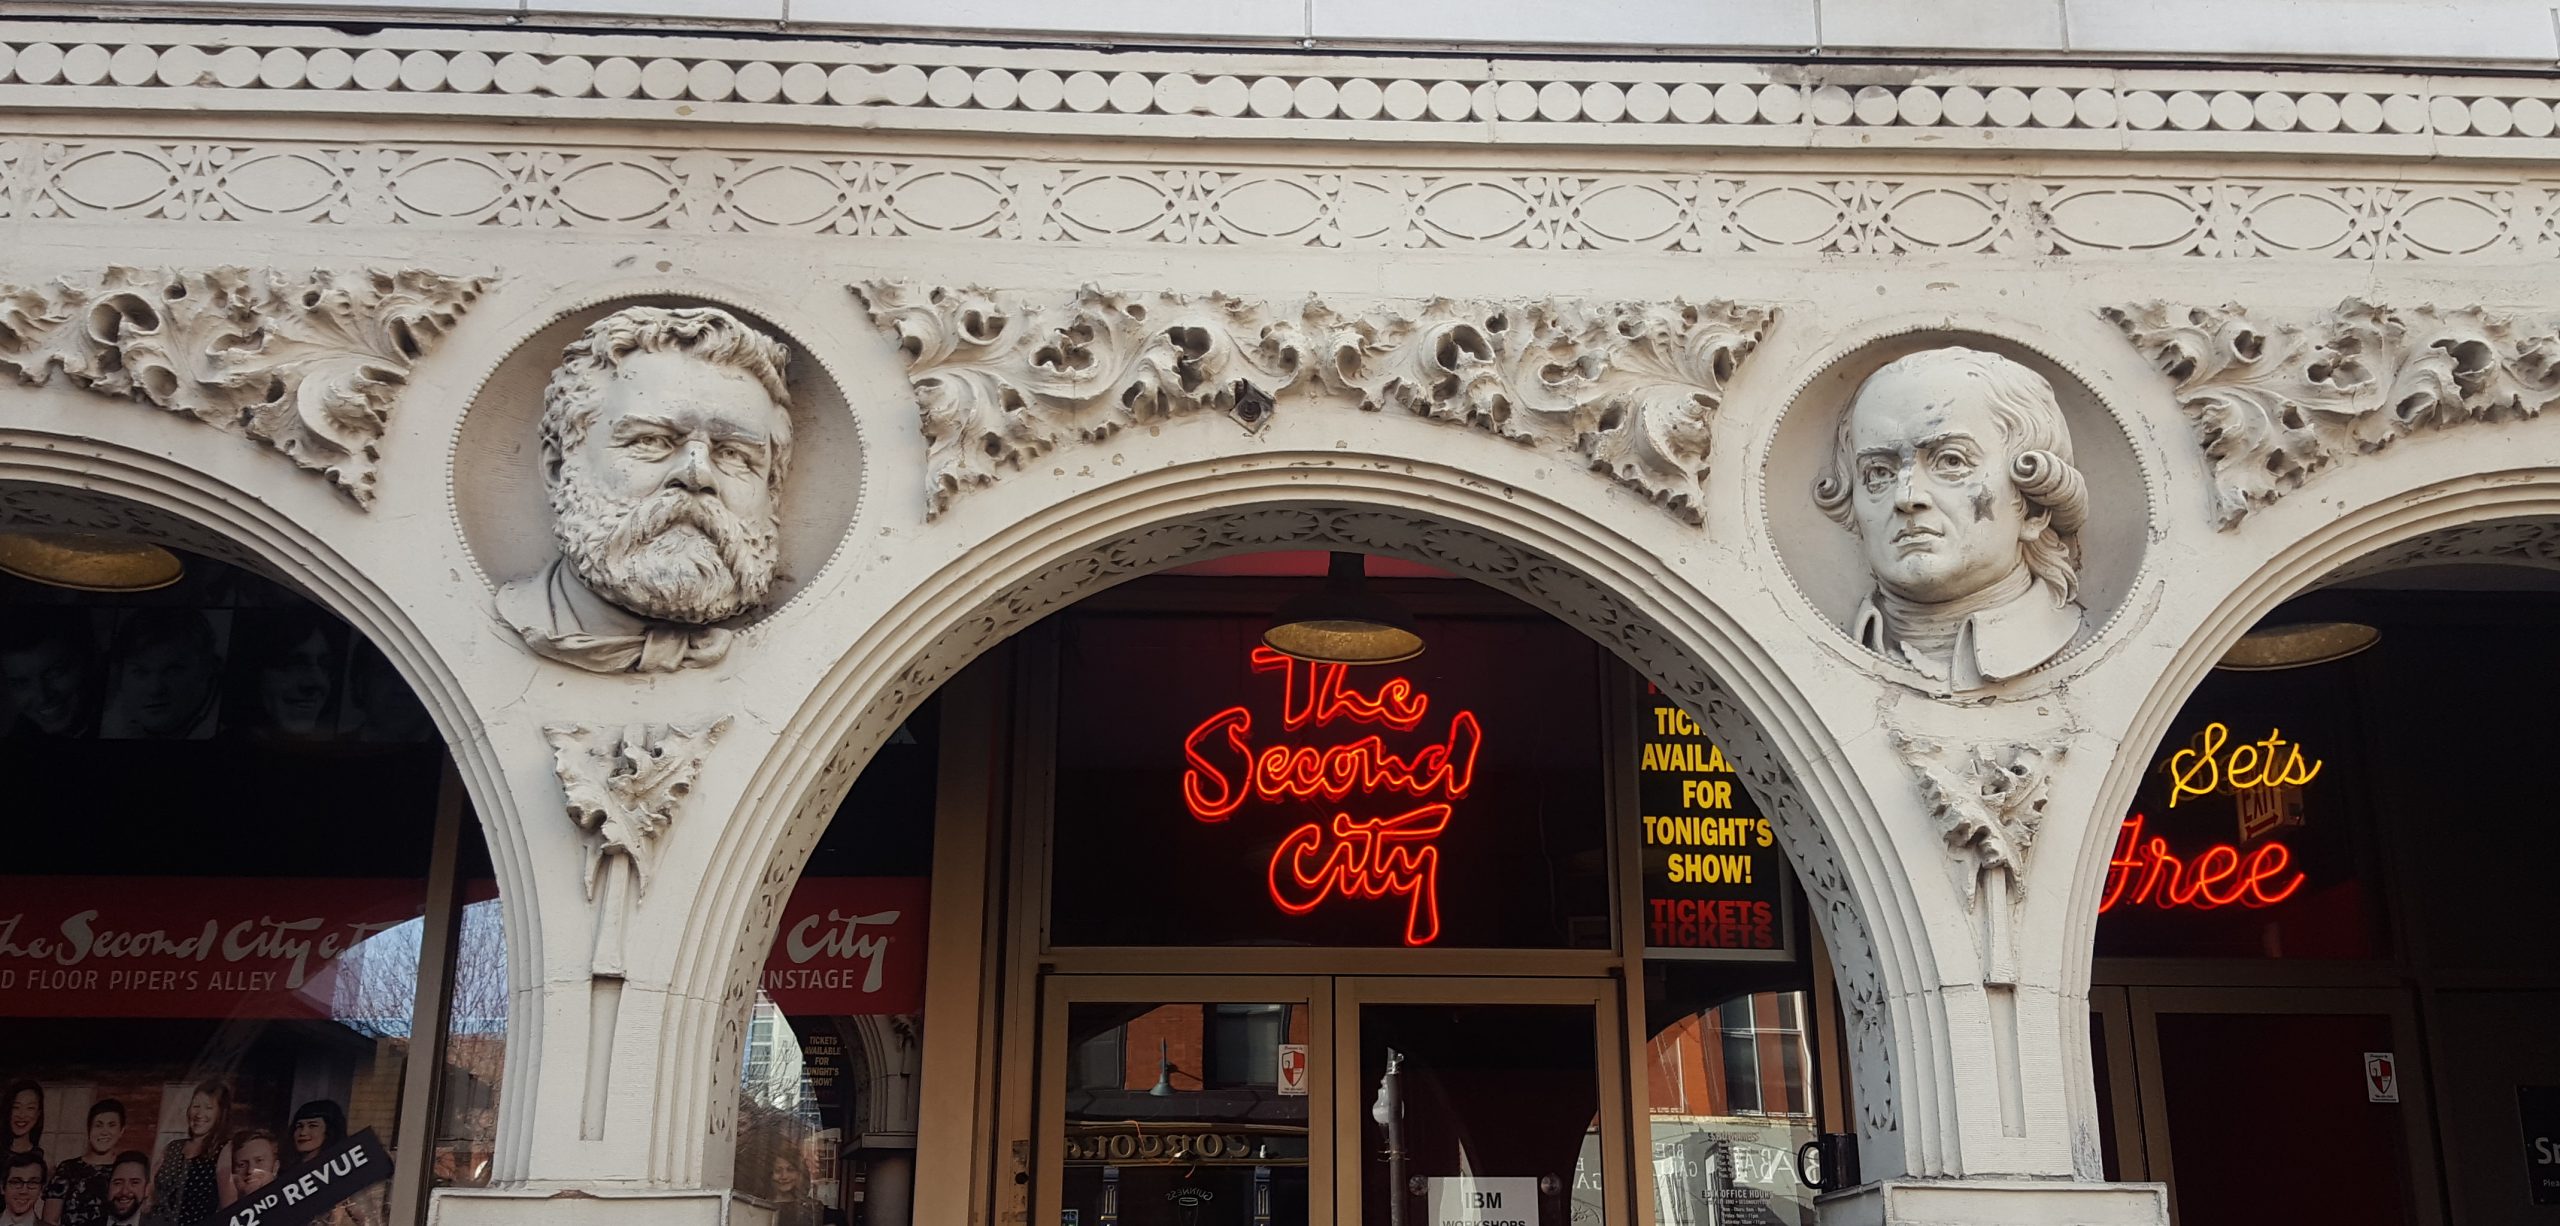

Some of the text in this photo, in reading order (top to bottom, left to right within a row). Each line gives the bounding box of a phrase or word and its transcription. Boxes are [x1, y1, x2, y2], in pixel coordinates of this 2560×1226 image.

[1251, 646, 1428, 726] The
[1654, 707, 1706, 735] TIC
[1184, 706, 1481, 817] Second
[2169, 722, 2323, 808] Sets
[1682, 780, 1732, 809] FOR
[1643, 815, 1773, 847] TONIGHT'S
[1269, 803, 1452, 945] City
[1667, 853, 1752, 884] SHOW!
[2097, 813, 2306, 914] Free
[1650, 899, 1773, 924] TICKETS
[56, 909, 218, 966] Second
[221, 916, 325, 989] City
[786, 908, 901, 993] City
[1651, 922, 1774, 949] TICKETS
[26, 970, 97, 990] FLOOR
[109, 971, 199, 991] PIPER'S
[208, 971, 277, 991] ALLEY
[229, 1144, 369, 1226] 42ND REVUE
[1465, 1192, 1502, 1208] IBM
[1721, 1189, 1748, 1198] OFFICE
